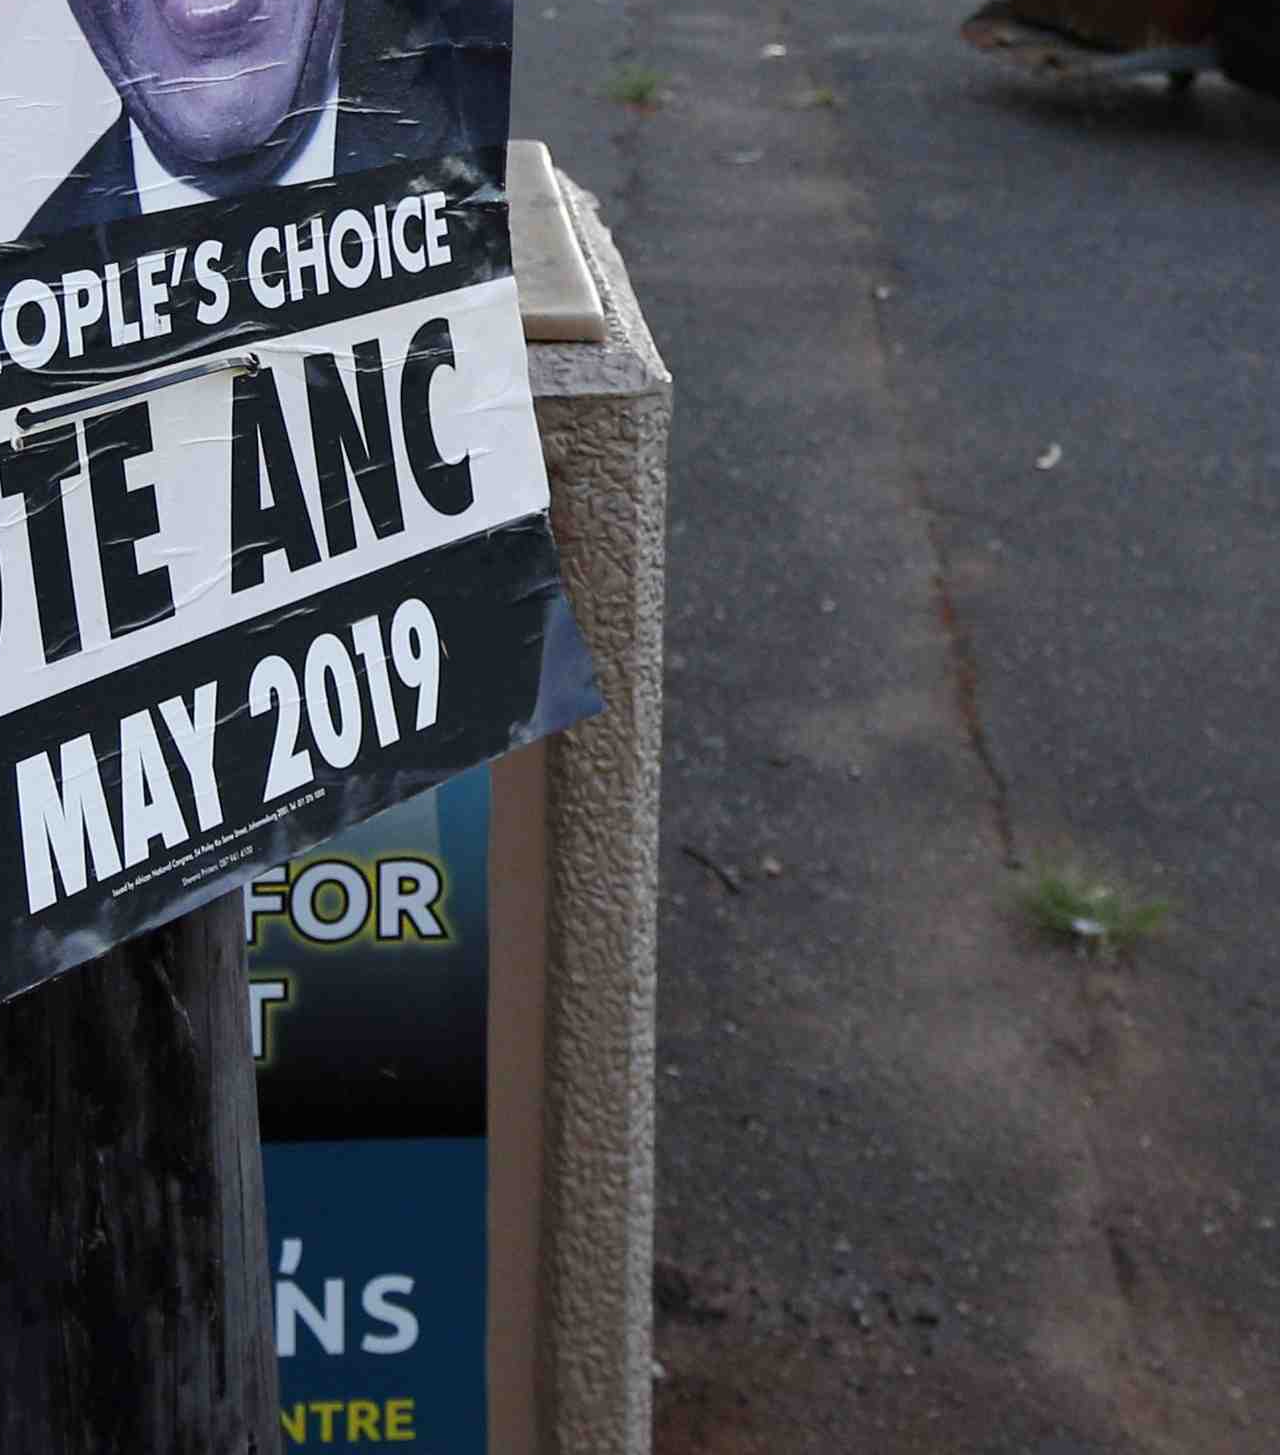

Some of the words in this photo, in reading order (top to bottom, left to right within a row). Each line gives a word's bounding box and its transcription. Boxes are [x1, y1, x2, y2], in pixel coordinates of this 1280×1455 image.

[247, 191, 452, 299] CHOICE
[230, 317, 476, 594] ANC
[15, 680, 226, 915] MAY
[249, 597, 442, 804] 2019
[243, 862, 448, 943] FOR
